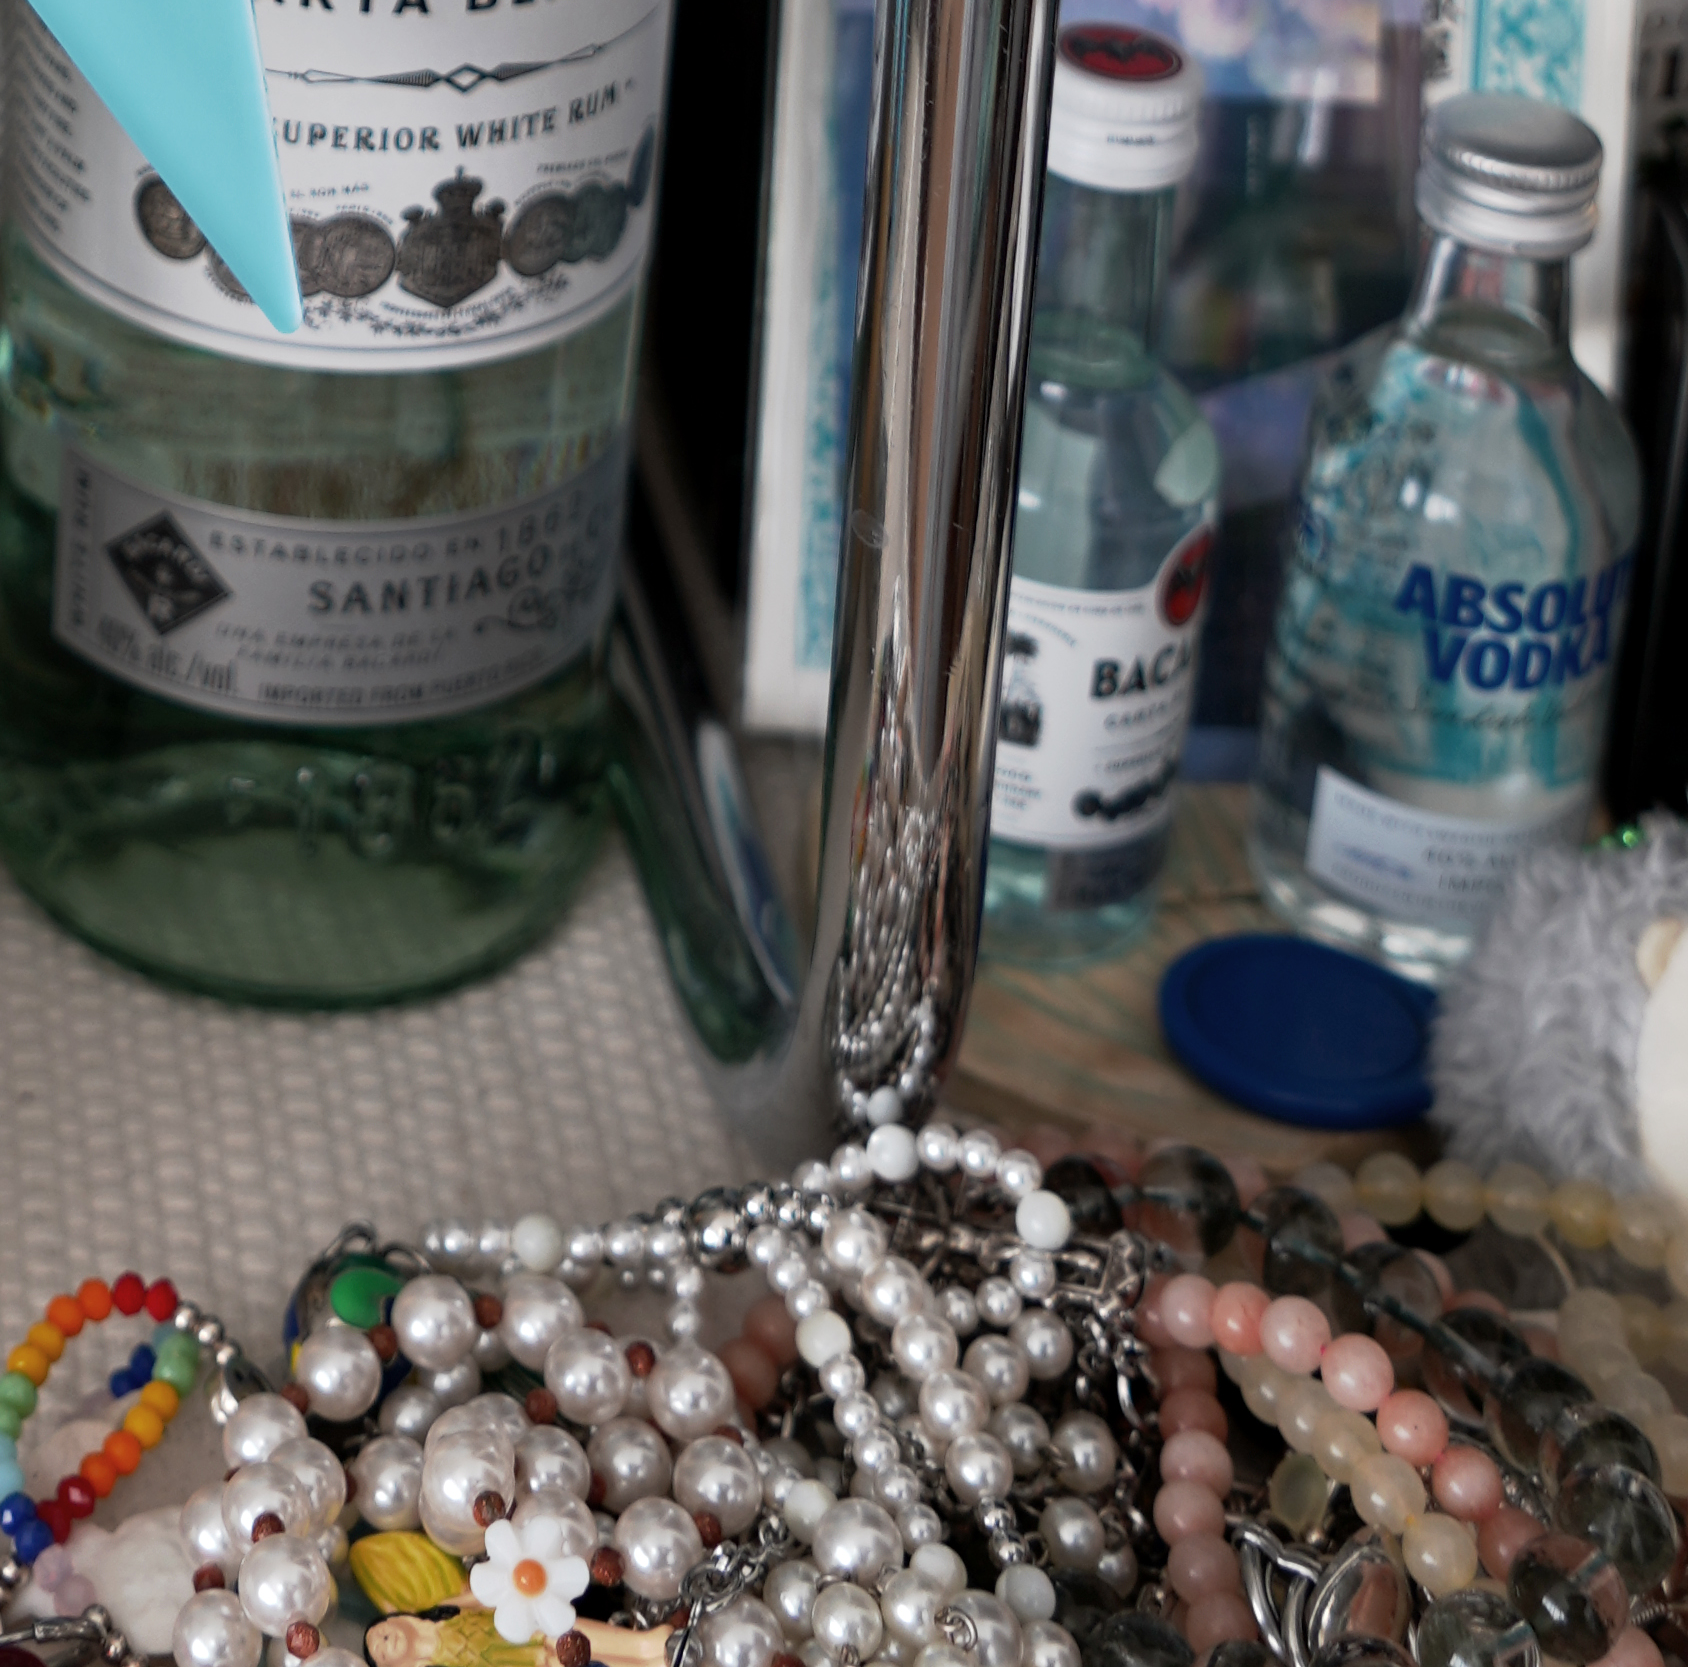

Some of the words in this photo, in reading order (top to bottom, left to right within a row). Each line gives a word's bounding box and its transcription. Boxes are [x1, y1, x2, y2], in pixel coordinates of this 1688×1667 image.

[275, 117, 441, 153] UPERIOR
[456, 105, 558, 151] WHITE
[569, 87, 618, 126] RUM
[308, 543, 552, 616] SANTIAGO
